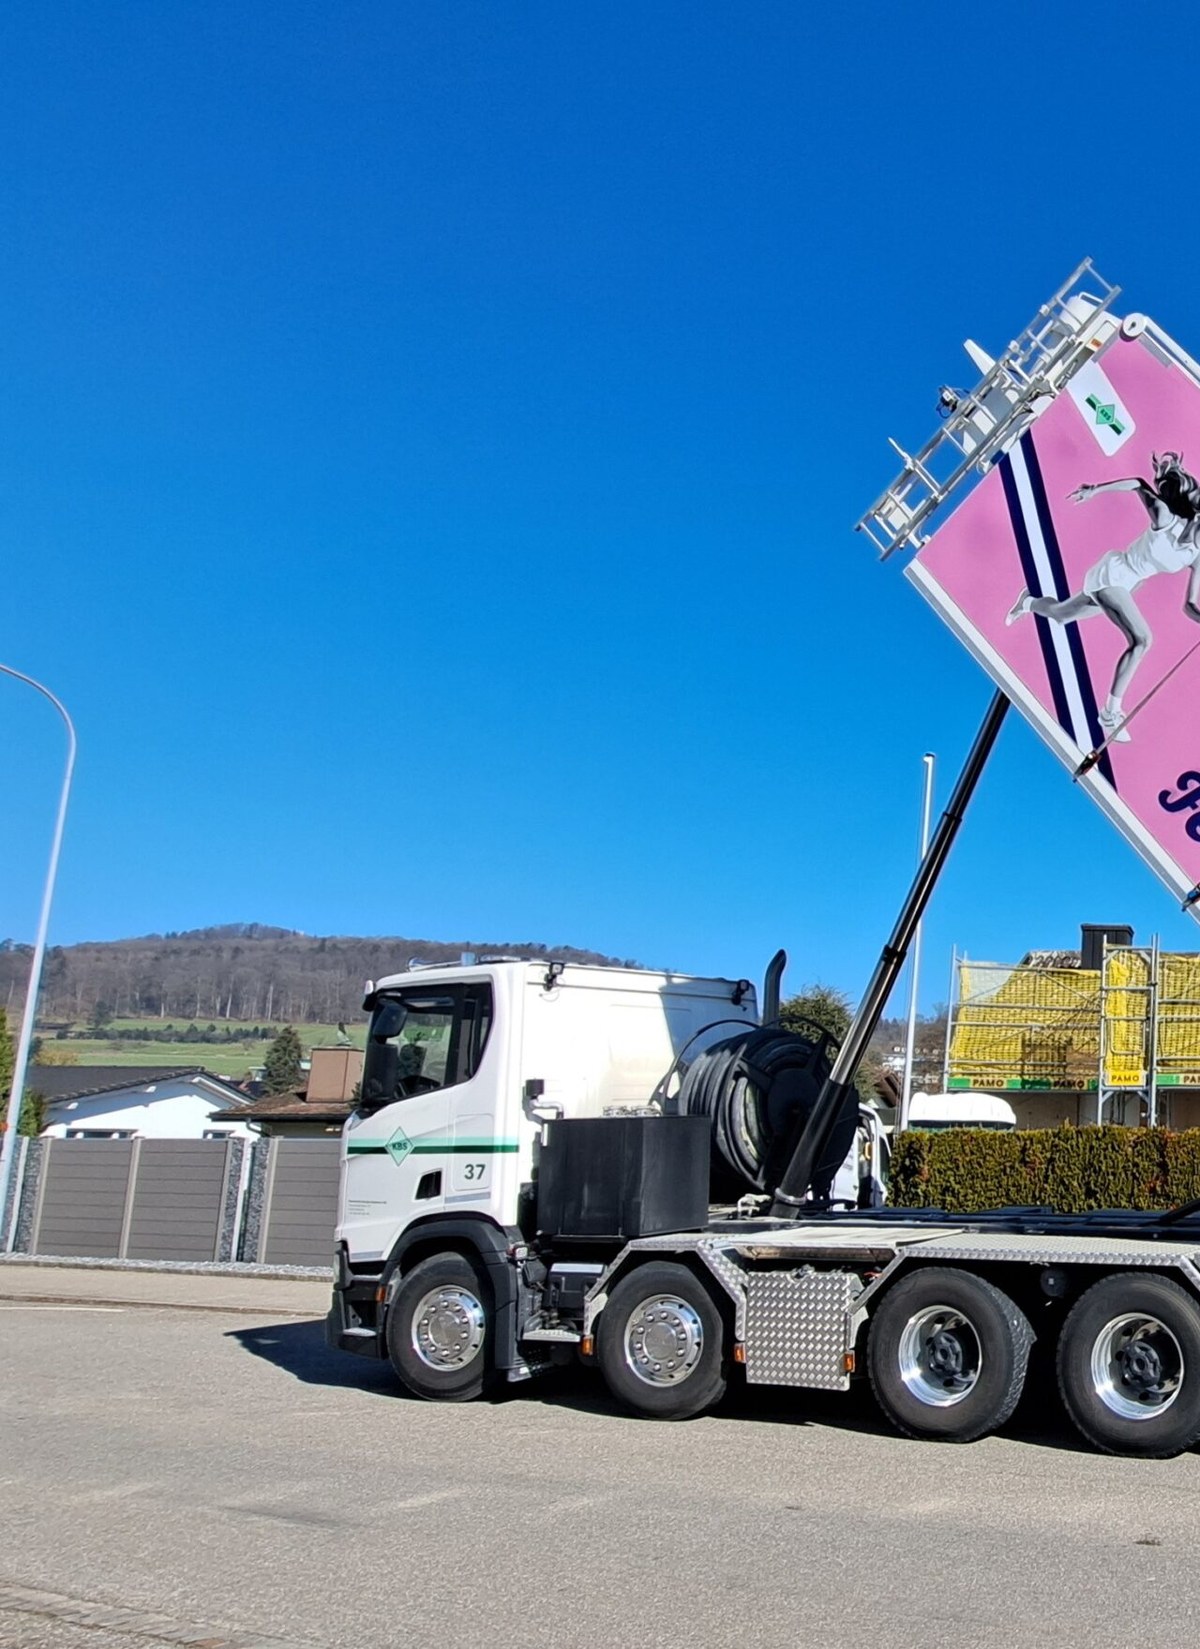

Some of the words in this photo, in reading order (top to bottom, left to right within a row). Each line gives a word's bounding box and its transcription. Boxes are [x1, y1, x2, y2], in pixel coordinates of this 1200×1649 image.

[972, 1078, 1005, 1088] PAMO
[1111, 1074, 1140, 1083] PAMO
[1053, 1079, 1085, 1089] PAMO
[391, 1141, 408, 1151] KBS
[464, 1163, 486, 1180] 37
